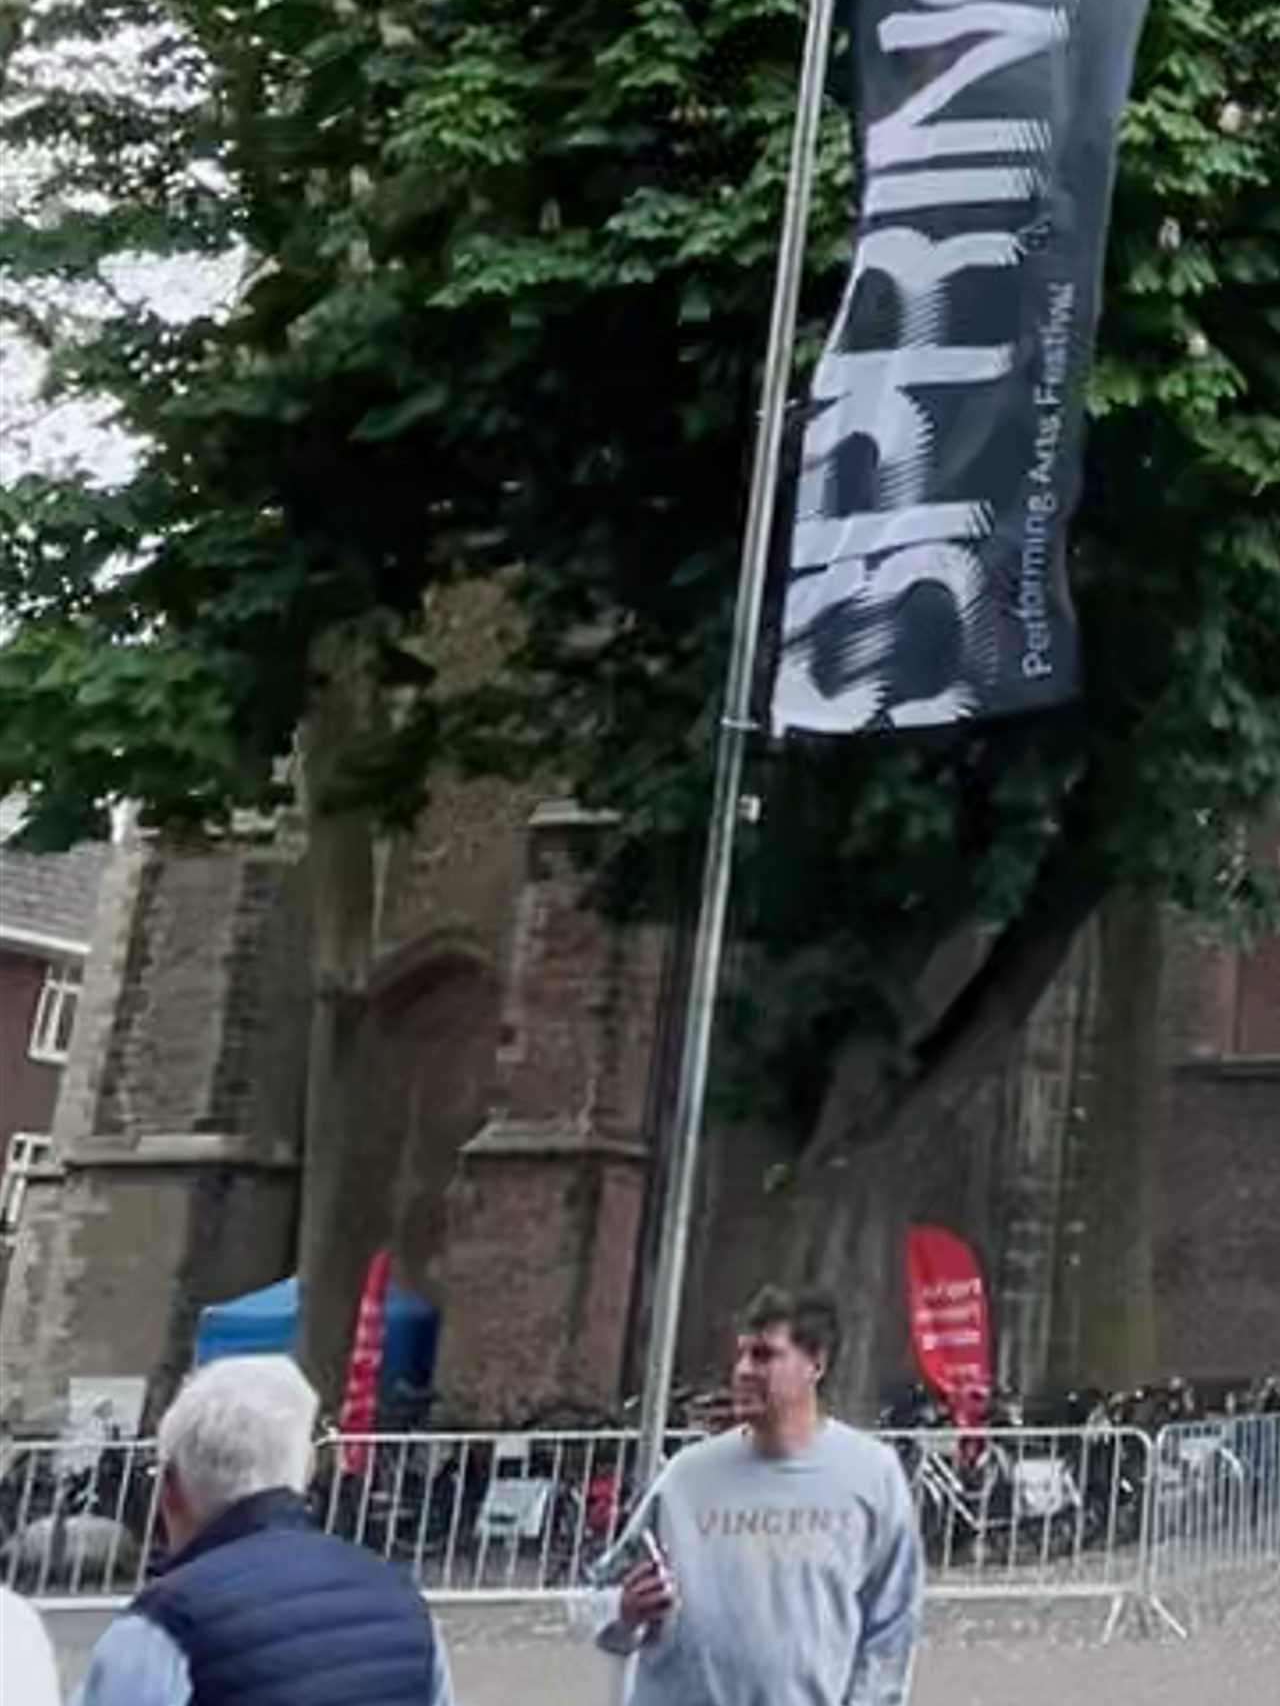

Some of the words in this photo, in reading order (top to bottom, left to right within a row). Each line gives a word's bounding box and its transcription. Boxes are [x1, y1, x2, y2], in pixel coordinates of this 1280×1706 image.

[1034, 283, 1075, 405] Festival
[1028, 418, 1062, 483] Arts
[1017, 491, 1057, 680] Performing
